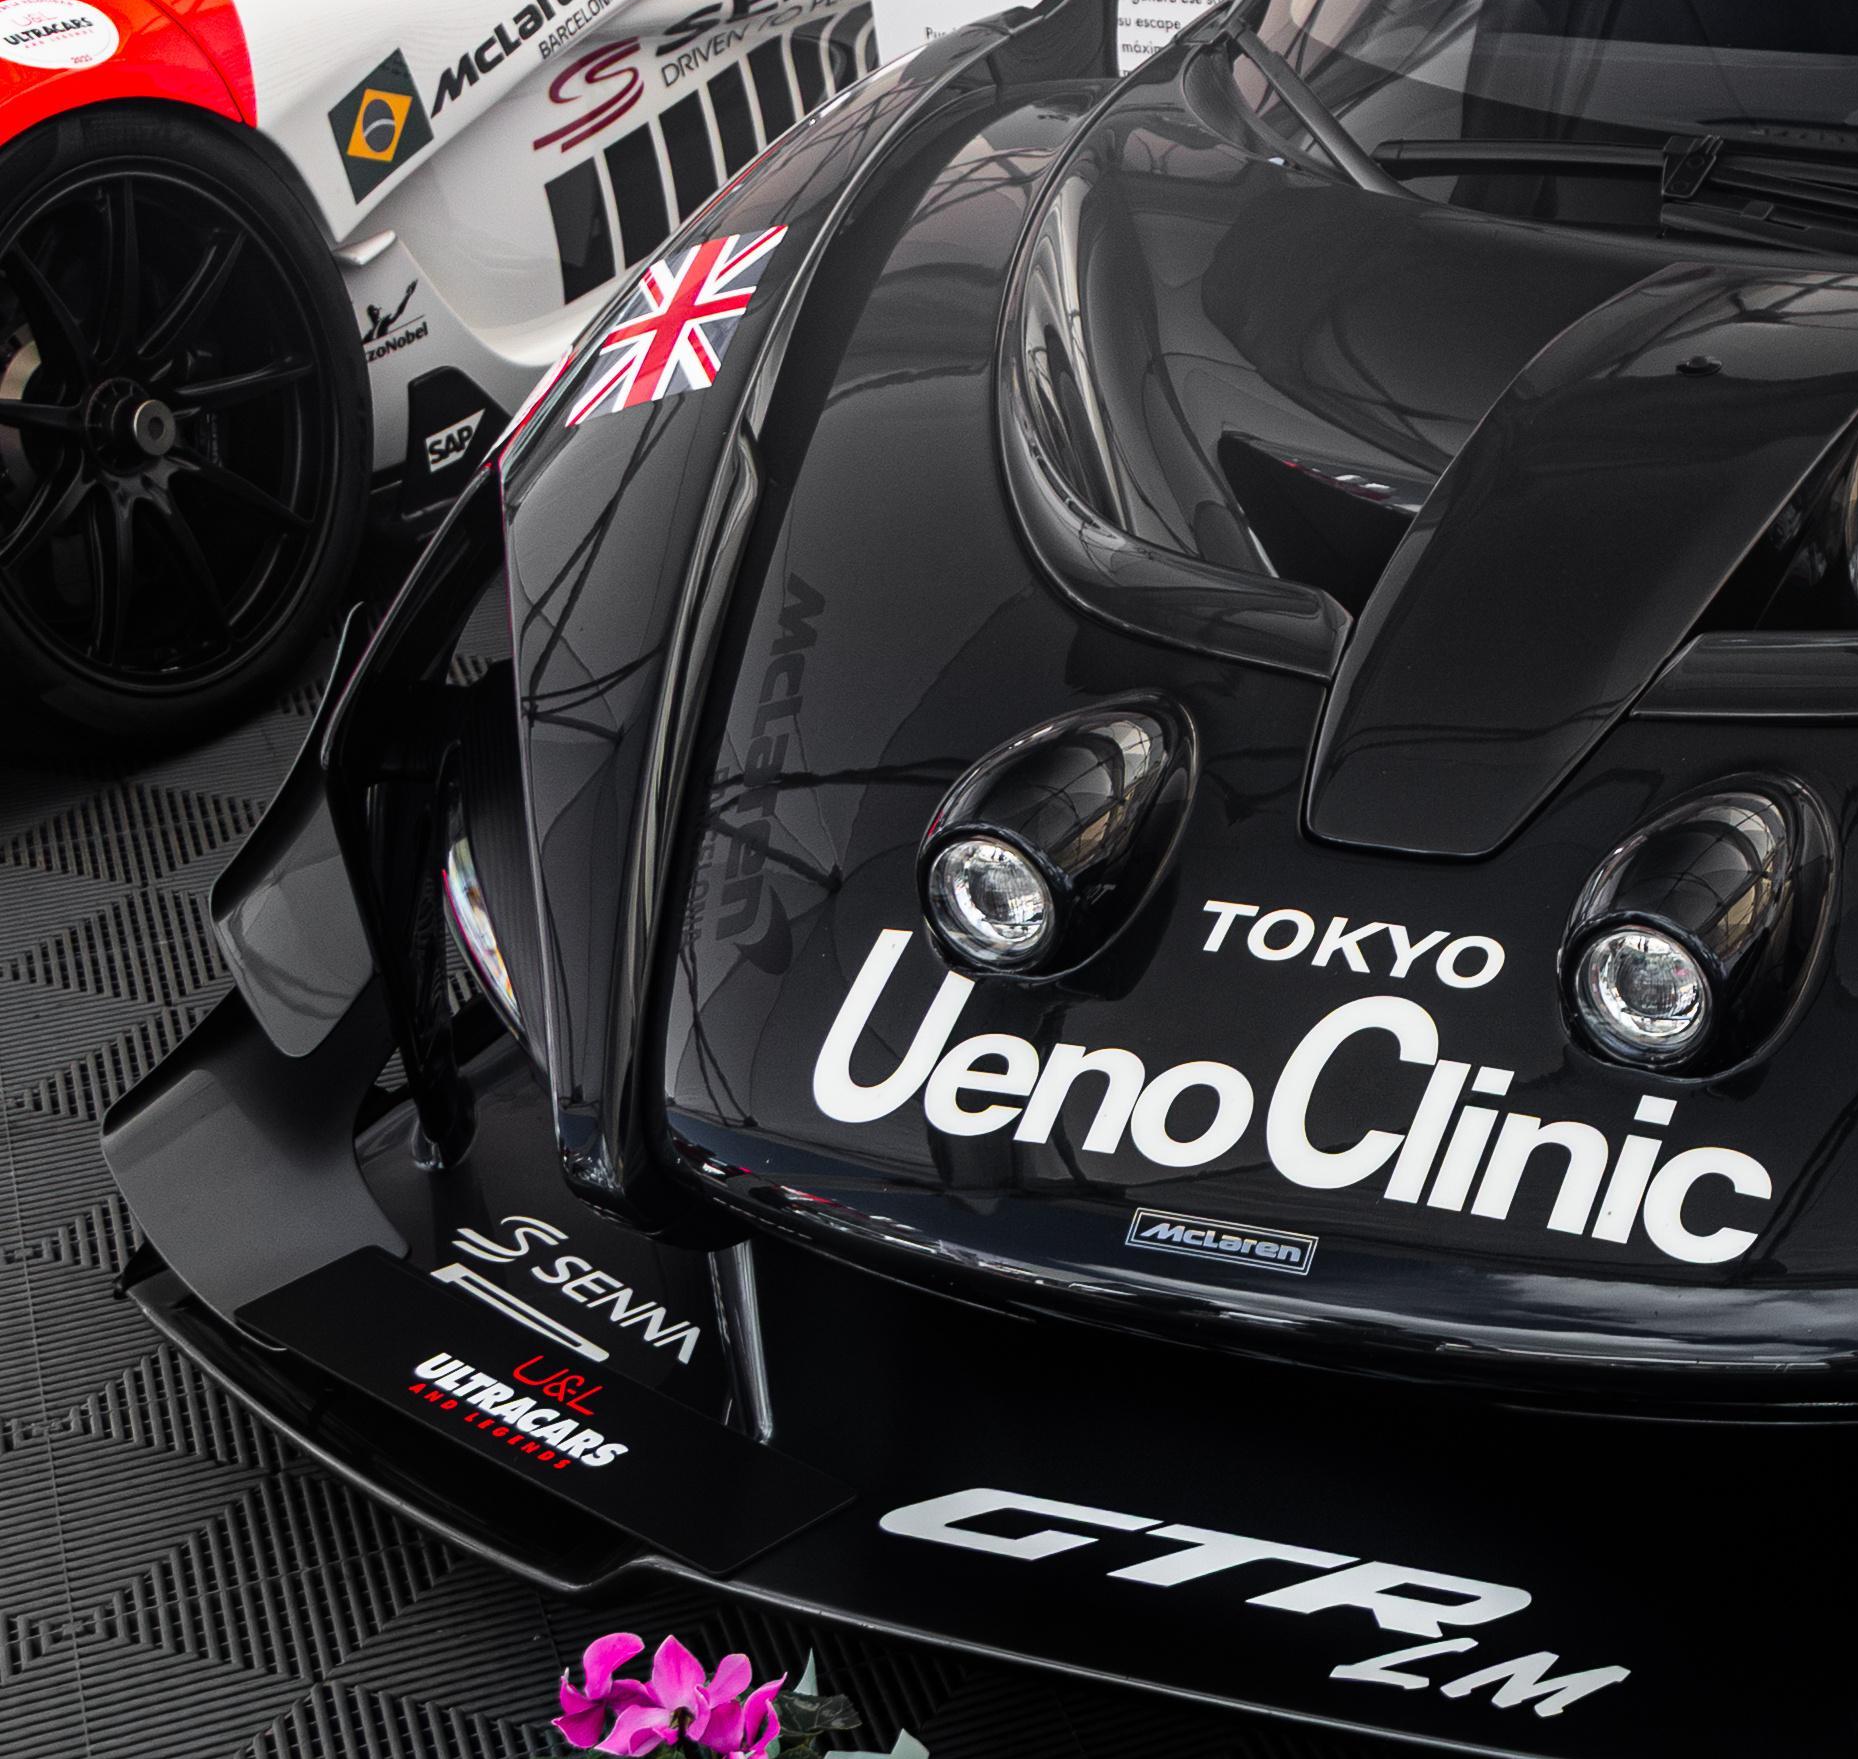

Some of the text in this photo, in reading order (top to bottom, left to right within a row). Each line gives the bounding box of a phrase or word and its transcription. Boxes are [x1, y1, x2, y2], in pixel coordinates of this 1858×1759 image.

[4, 17, 93, 45] ULTRACARS
[661, 23, 749, 88] DRIVEN
[1135, 18, 1181, 33] escape
[429, 425, 473, 465] SAP
[1200, 899, 1507, 990] TOKYO
[1140, 1222, 1302, 1262] McLaren
[531, 1256, 700, 1364] SENNA
[409, 1383, 571, 1469] AND LEGENDS
[414, 1352, 629, 1467] ULTRACARS
[878, 1487, 1533, 1638] GTR
